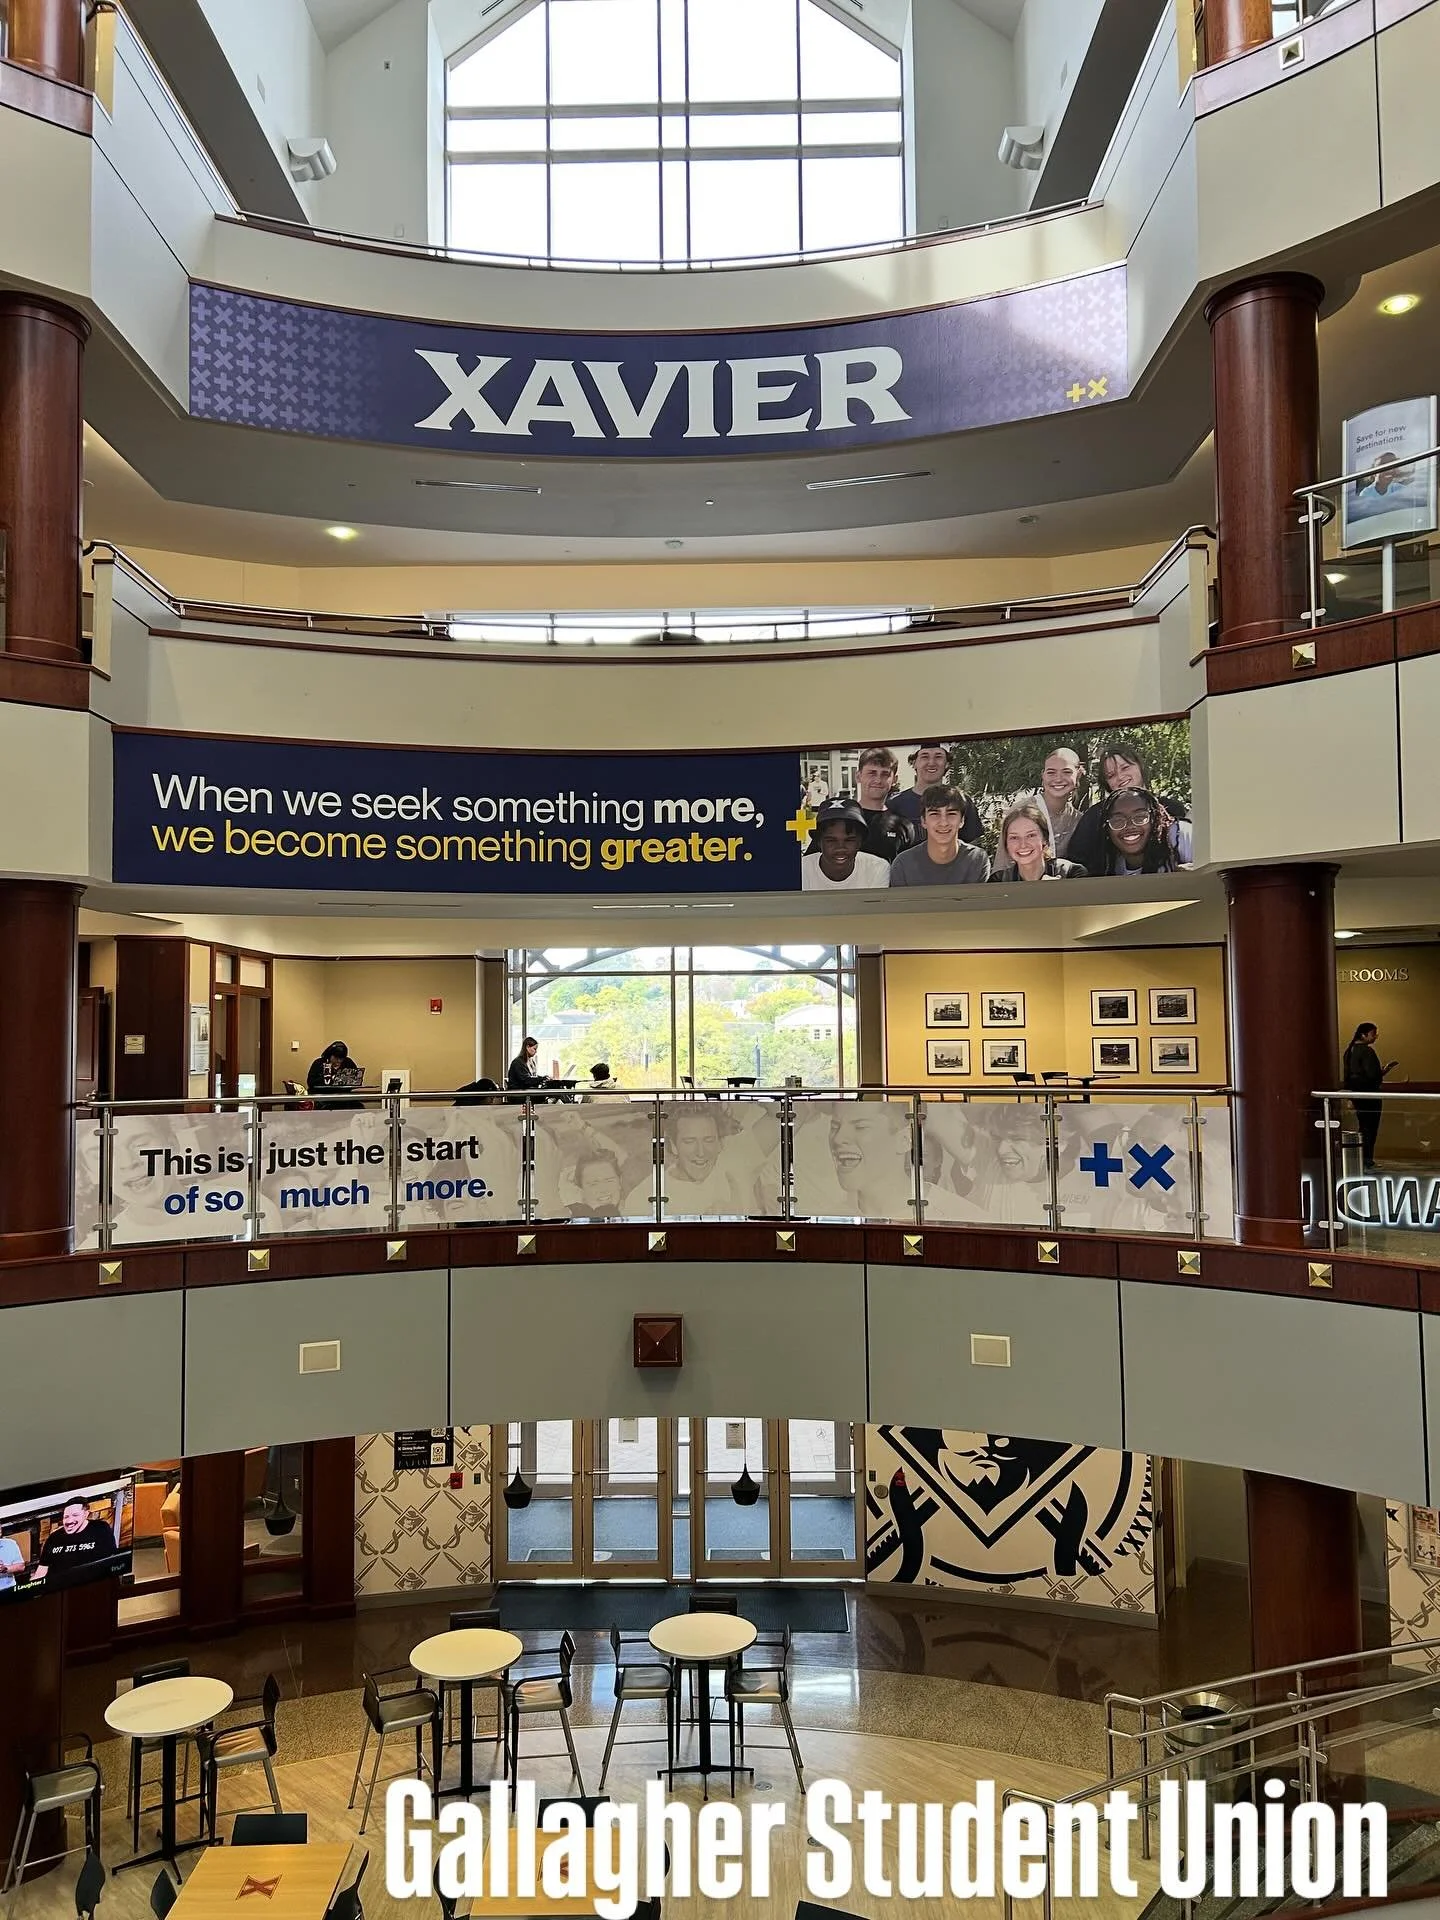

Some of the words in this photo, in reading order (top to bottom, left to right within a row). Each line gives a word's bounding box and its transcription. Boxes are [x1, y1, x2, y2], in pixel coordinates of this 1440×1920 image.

[414, 346, 912, 439] XAVIER
[1356, 434, 1374, 444] Save
[1375, 428, 1387, 438] for
[1388, 425, 1406, 435] new
[152, 774, 273, 815] When
[283, 790, 341, 818] we
[351, 787, 443, 821] seek
[453, 791, 644, 832] something
[653, 797, 764, 829] more,
[152, 825, 214, 852] we
[225, 820, 386, 859] become
[396, 831, 591, 870] something
[600, 833, 752, 870] greater.
[1337, 967, 1409, 982] TROOMS
[140, 1147, 212, 1176] This
[219, 1146, 245, 1174] is
[266, 1140, 328, 1174] just
[334, 1139, 384, 1166] the
[406, 1135, 479, 1162] start
[164, 1186, 200, 1214] of
[205, 1191, 244, 1213] so
[280, 1179, 370, 1209] much
[406, 1175, 493, 1201] more.
